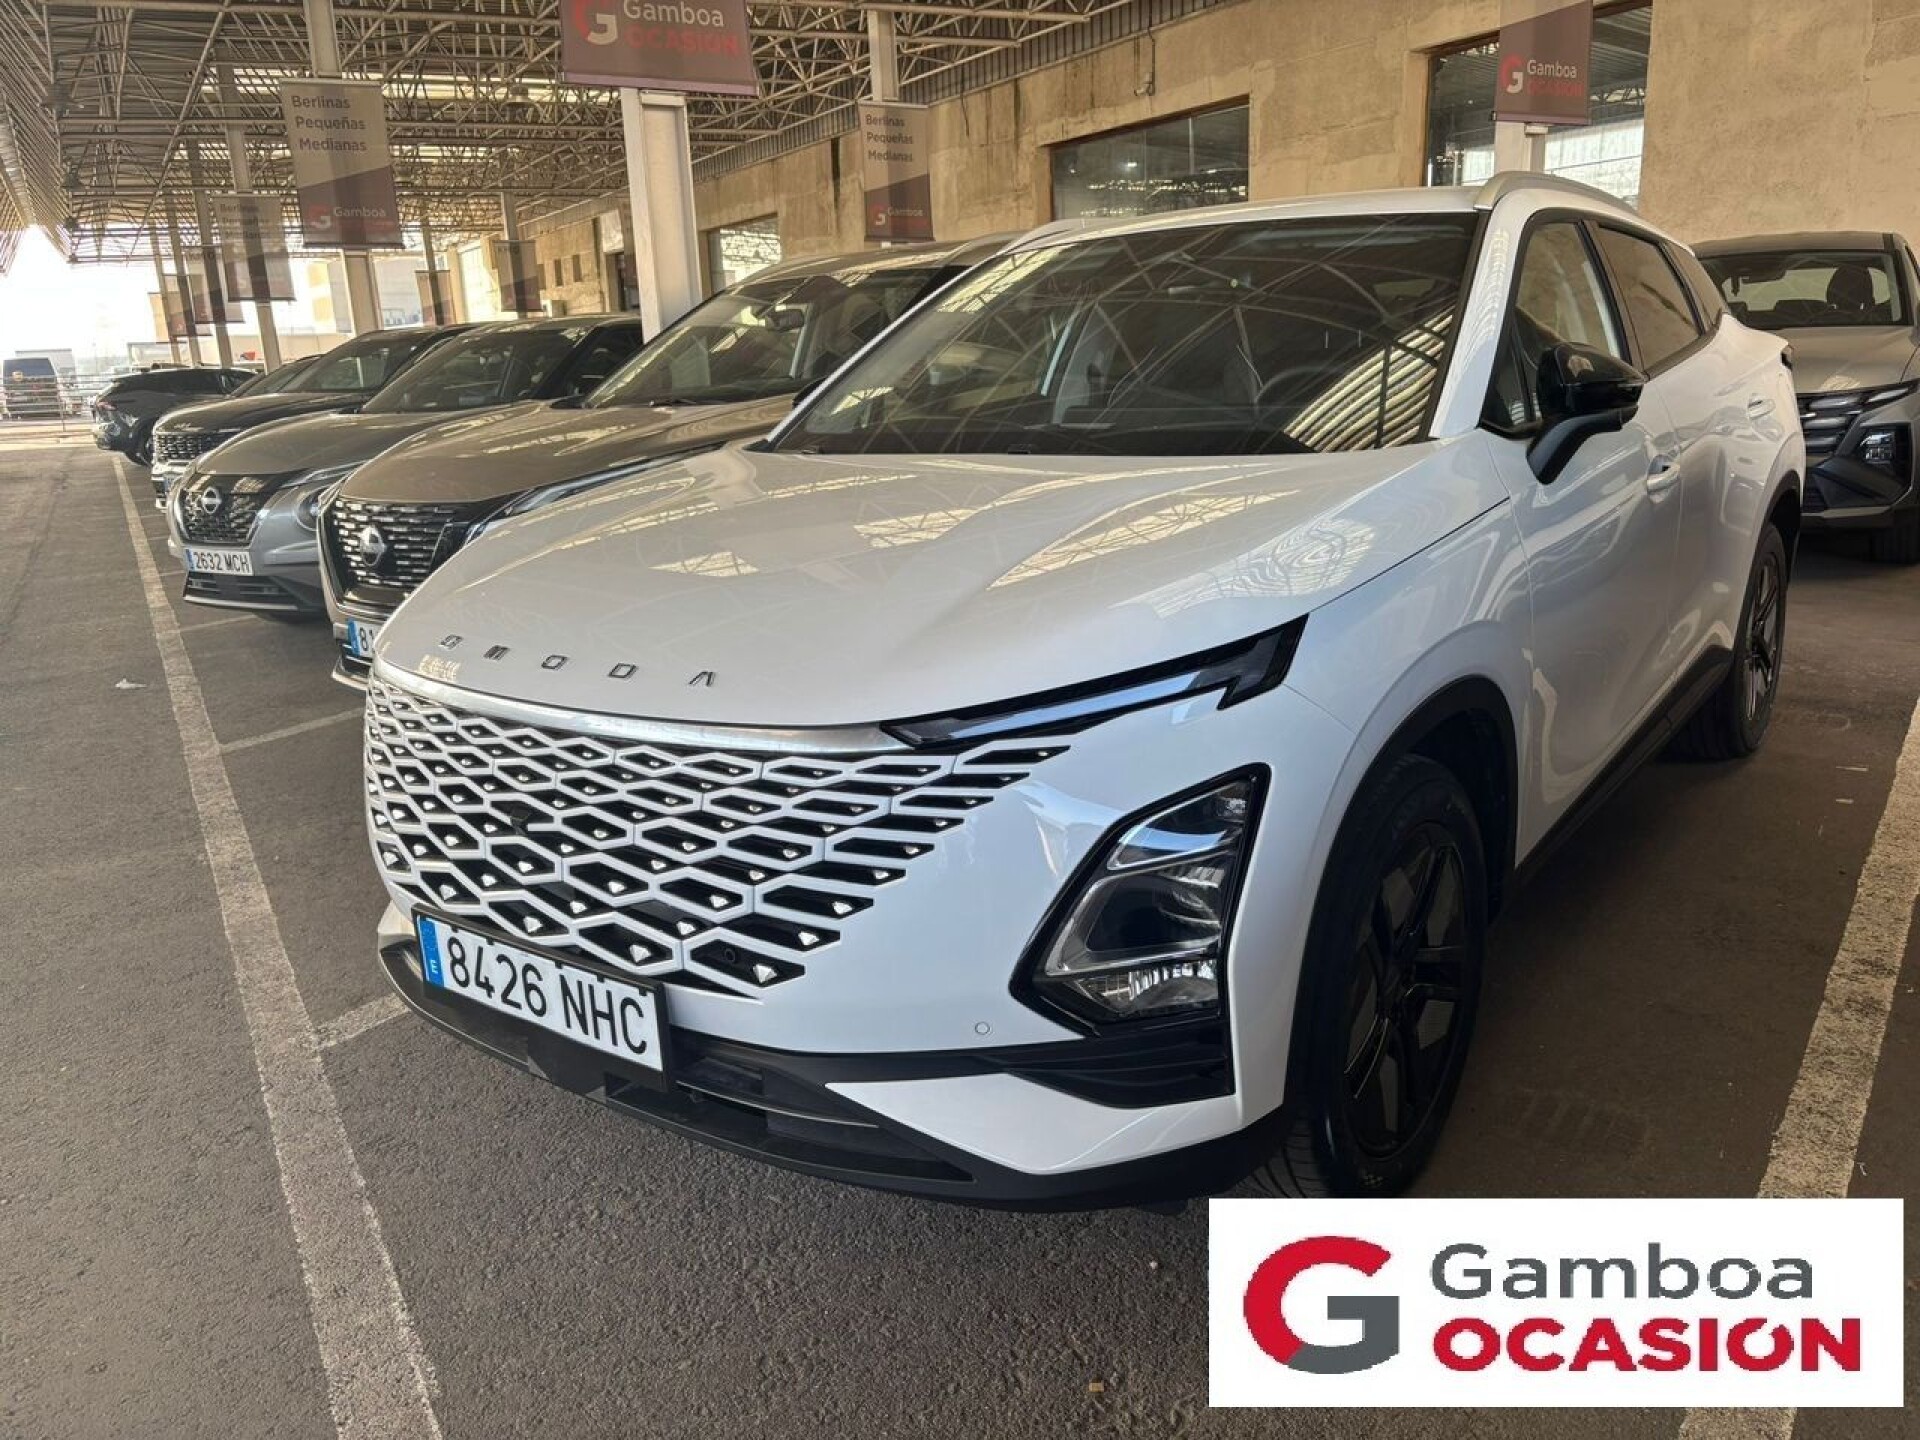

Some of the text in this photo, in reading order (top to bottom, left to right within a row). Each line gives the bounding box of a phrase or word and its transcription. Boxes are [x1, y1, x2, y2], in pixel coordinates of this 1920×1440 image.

[623, 0, 725, 27] Gamboa
[1526, 59, 1578, 79] Gamboa
[291, 95, 351, 109] Berlinas
[295, 116, 367, 132] Pequeñas
[299, 137, 368, 152] Medianas
[333, 205, 387, 218] Gamboa
[193, 551, 250, 574] 2632 MCH
[447, 936, 648, 1055] 8426 NHC
